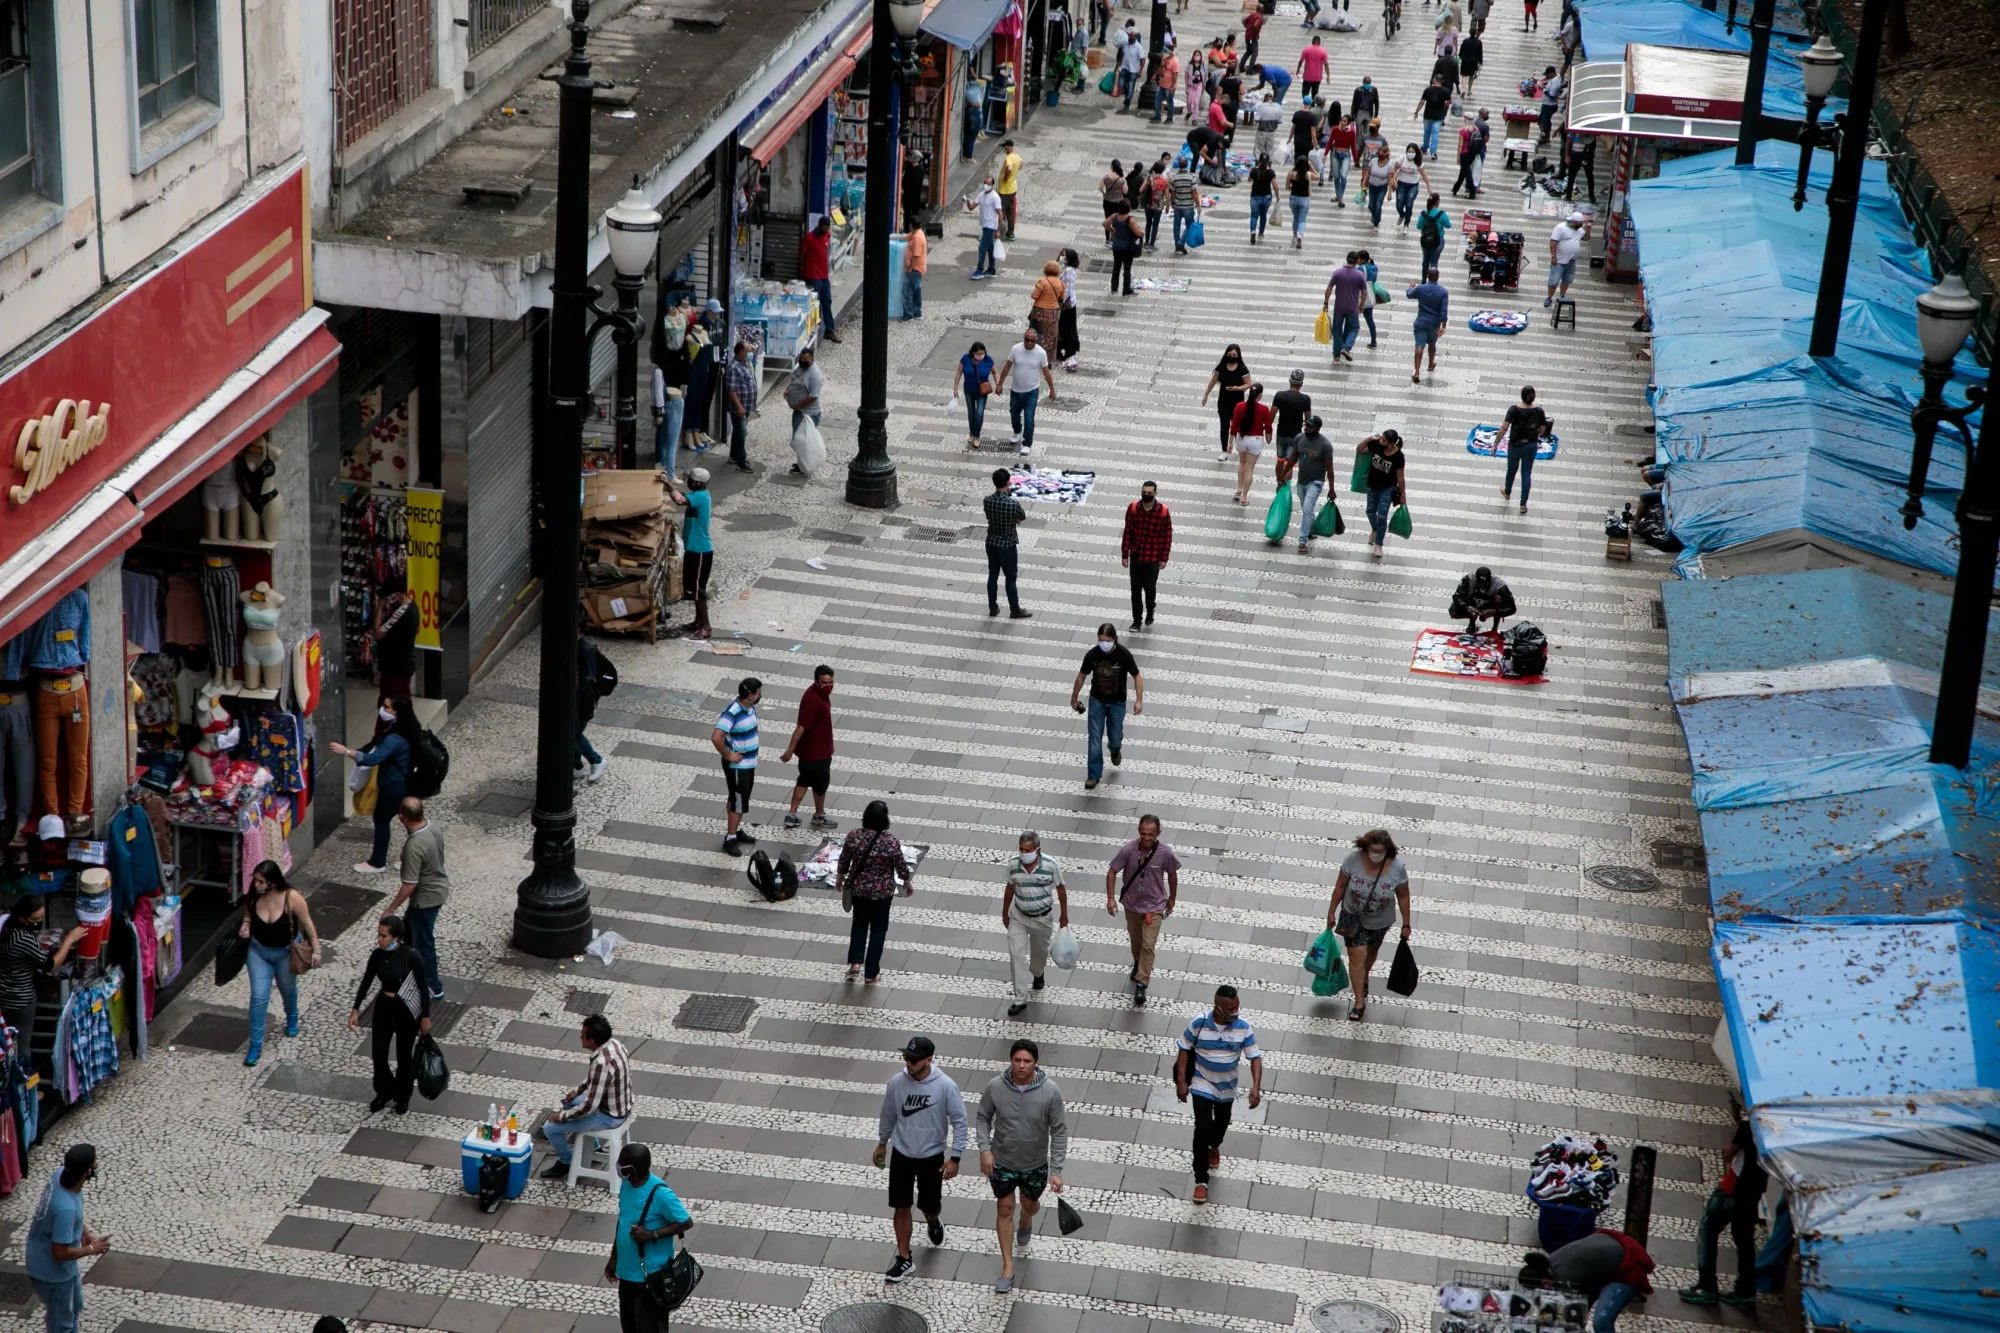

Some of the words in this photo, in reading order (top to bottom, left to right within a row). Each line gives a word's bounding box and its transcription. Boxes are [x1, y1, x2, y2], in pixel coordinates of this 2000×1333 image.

[10, 398, 111, 504] Modas
[406, 506, 443, 528] PREÇO
[406, 534, 442, 559] ÚNICO
[904, 1094, 931, 1107] NIKE
